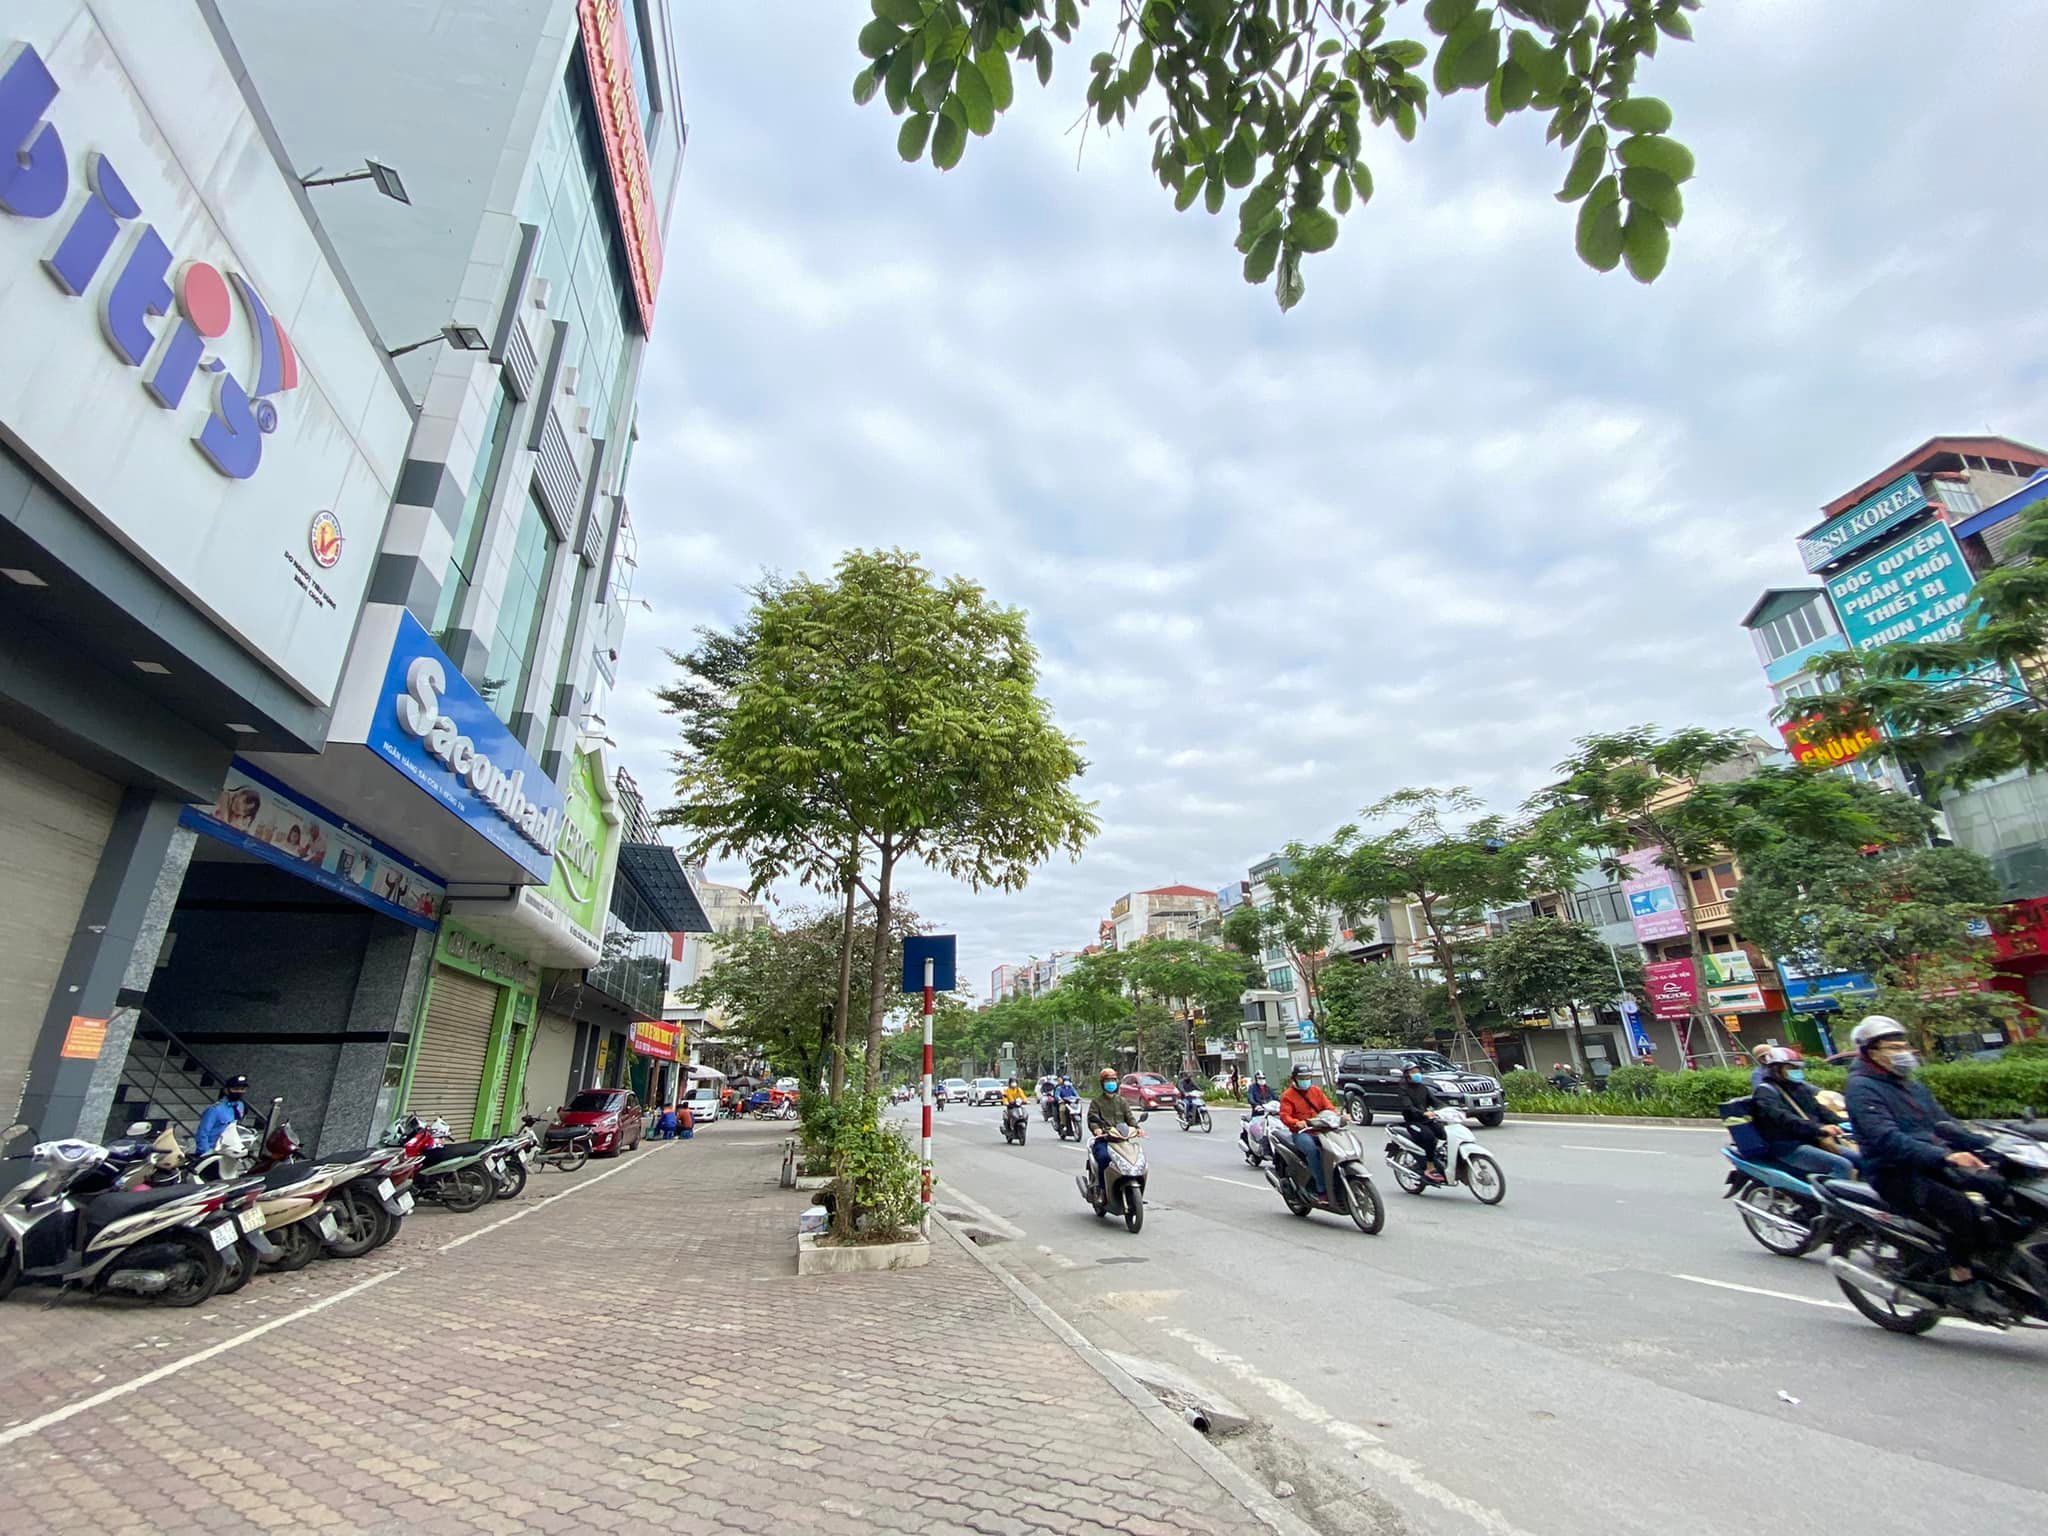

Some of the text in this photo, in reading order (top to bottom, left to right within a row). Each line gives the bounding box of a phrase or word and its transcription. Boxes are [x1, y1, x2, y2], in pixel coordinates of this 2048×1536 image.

[1849, 485, 1921, 535] KOREA
[1833, 531, 1945, 599] ĐỘC QUYỀN
[1844, 551, 1952, 615] PHÂN PHỐI
[1860, 592, 1968, 652] PHUN XĂM
[1864, 578, 1946, 626] THIẾT BỊ
[383, 741, 401, 760] NGÂN
[397, 656, 562, 855] Sacombank
